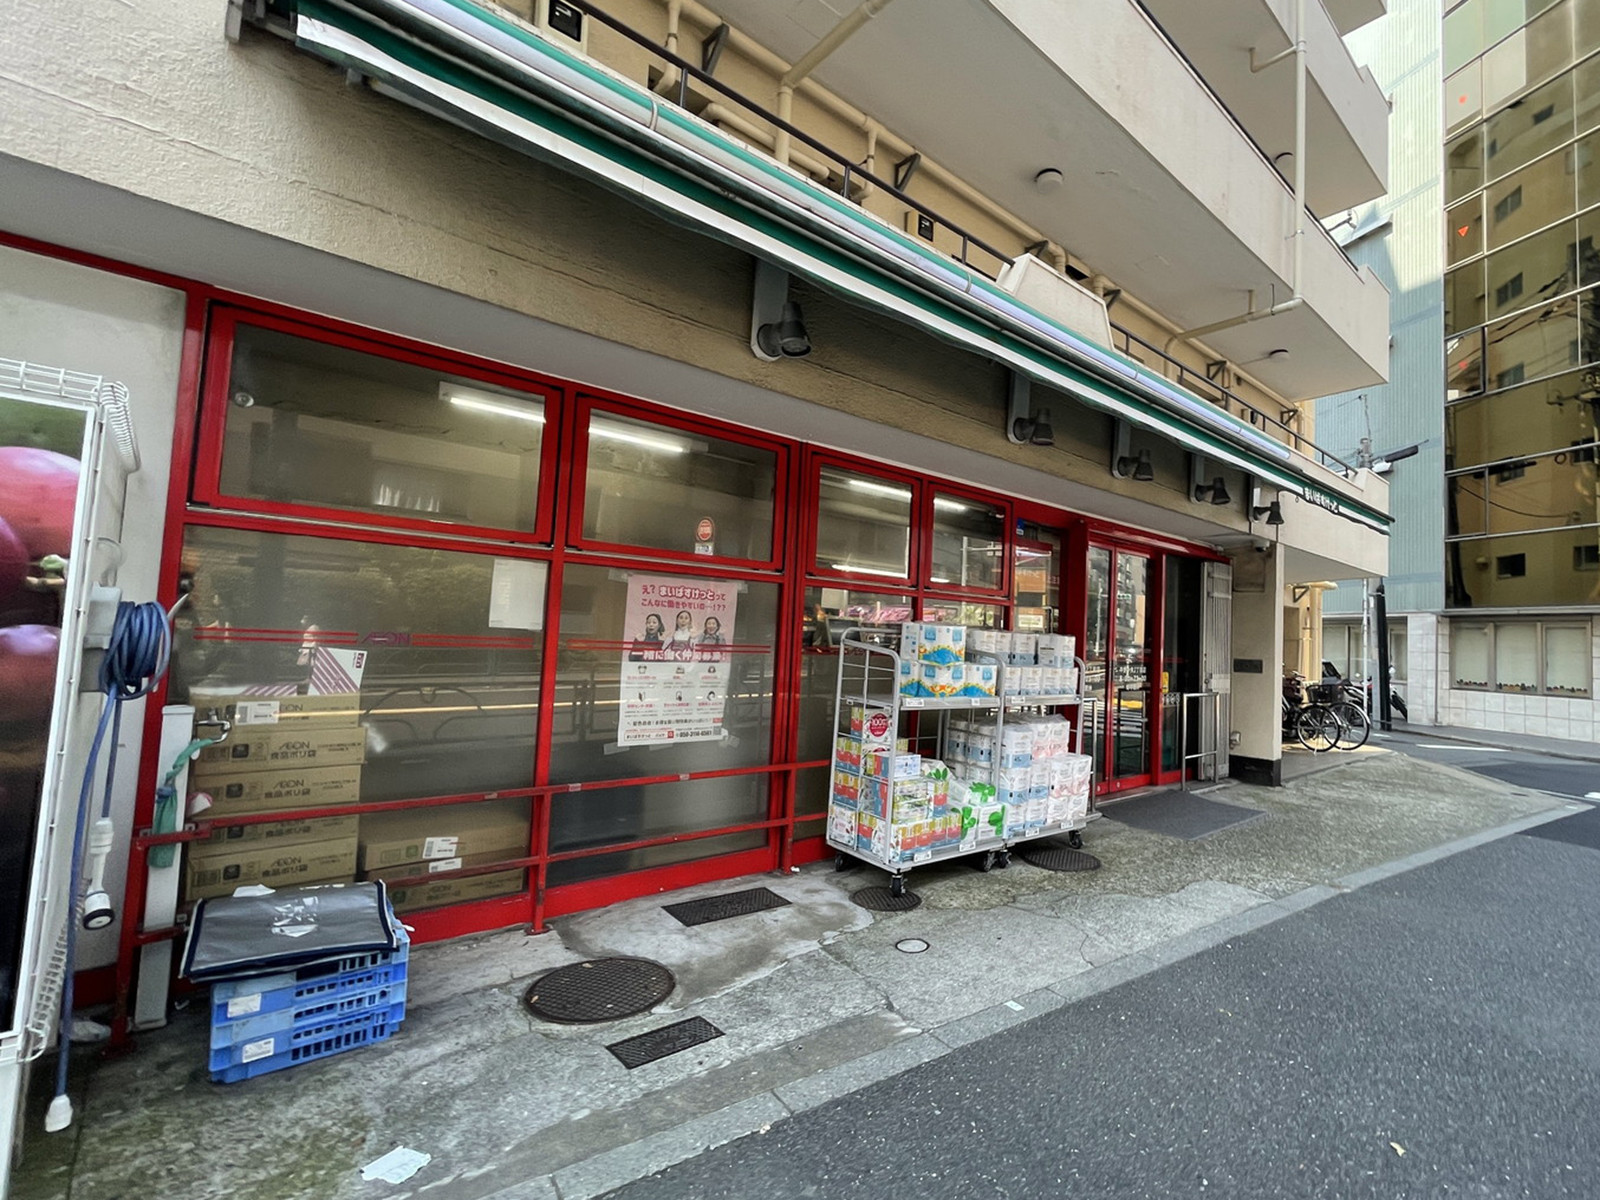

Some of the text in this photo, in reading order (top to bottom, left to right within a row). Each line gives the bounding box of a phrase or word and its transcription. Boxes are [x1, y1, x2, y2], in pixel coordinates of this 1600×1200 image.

[1304, 486, 1338, 513] まいばすけっと
